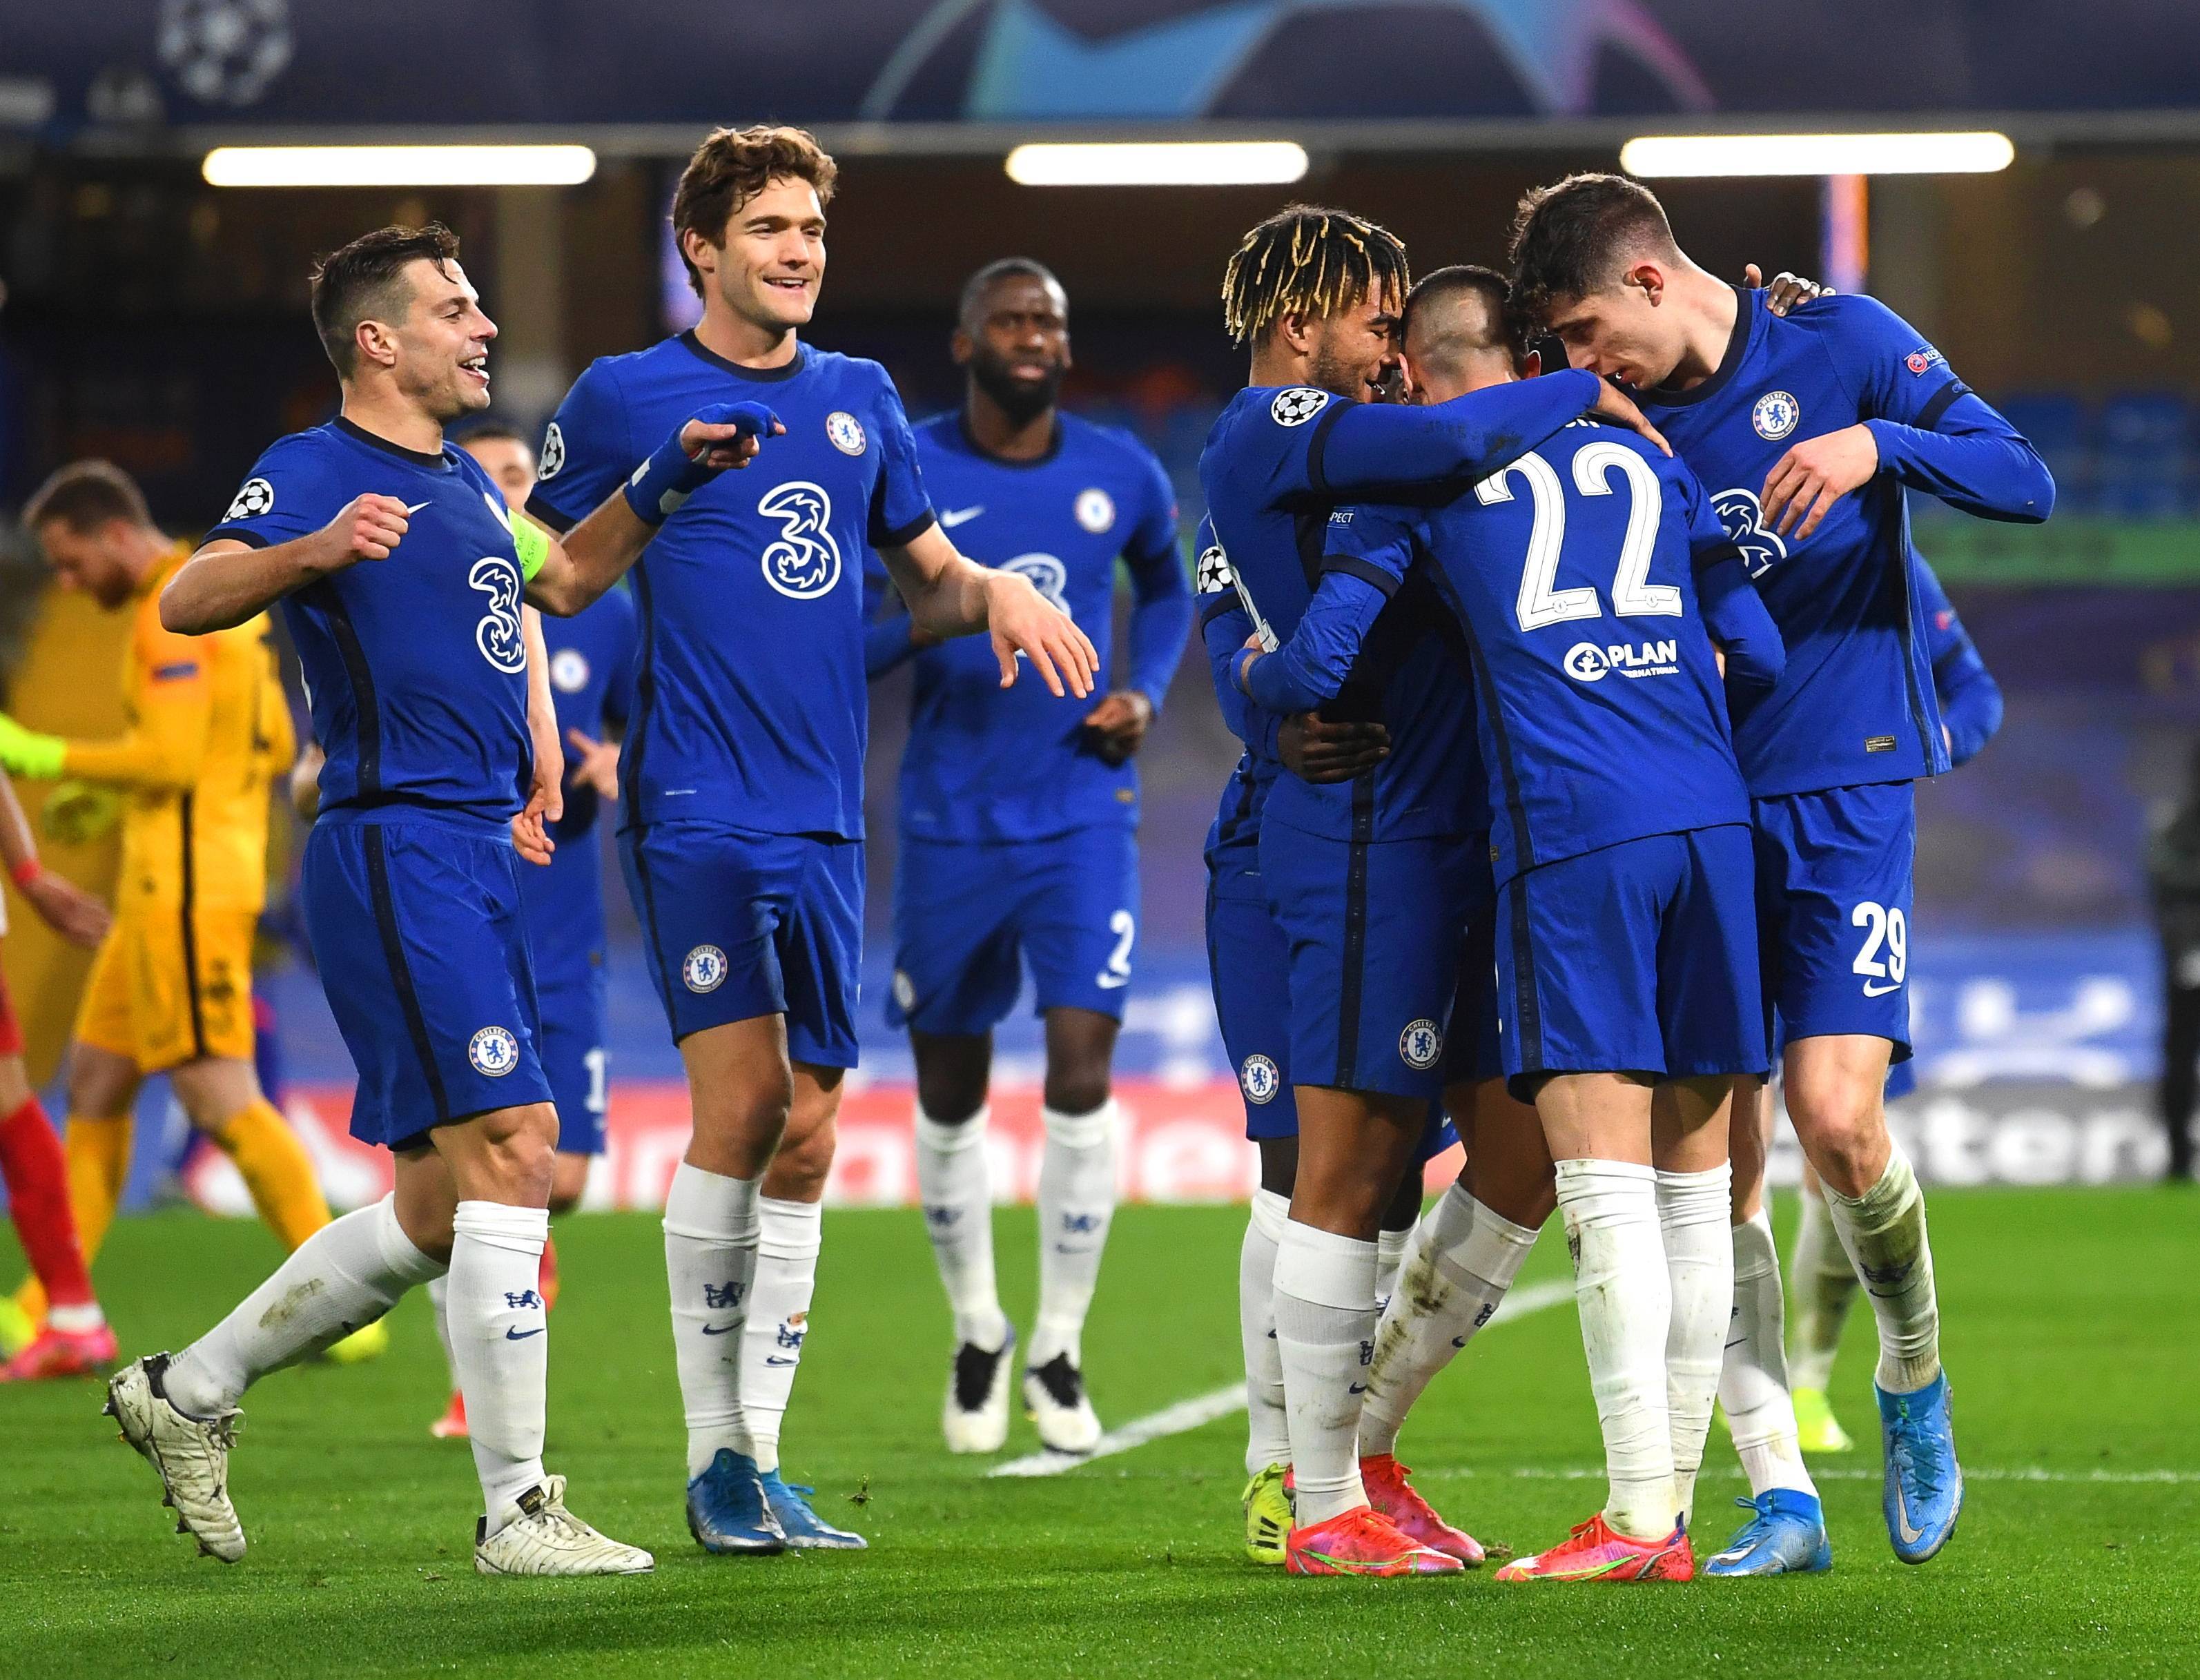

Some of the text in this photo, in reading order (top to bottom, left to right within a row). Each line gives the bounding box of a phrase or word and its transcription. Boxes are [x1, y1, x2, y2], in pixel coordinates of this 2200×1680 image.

[1758, 393, 1787, 409] CHELSEA
[1330, 511, 1354, 523] PECT
[758, 480, 841, 600] 3
[1474, 442, 1682, 632] 22
[469, 557, 526, 674] 3
[1608, 639, 1677, 667] PLAN
[690, 946, 717, 961] CHELSEA
[1108, 910, 1134, 977] 2
[1852, 901, 1906, 984] 29
[475, 1028, 506, 1042] CHELSEA
[1408, 1022, 1436, 1032] CHELSEA
[1245, 1056, 1269, 1068] CHELSEA
